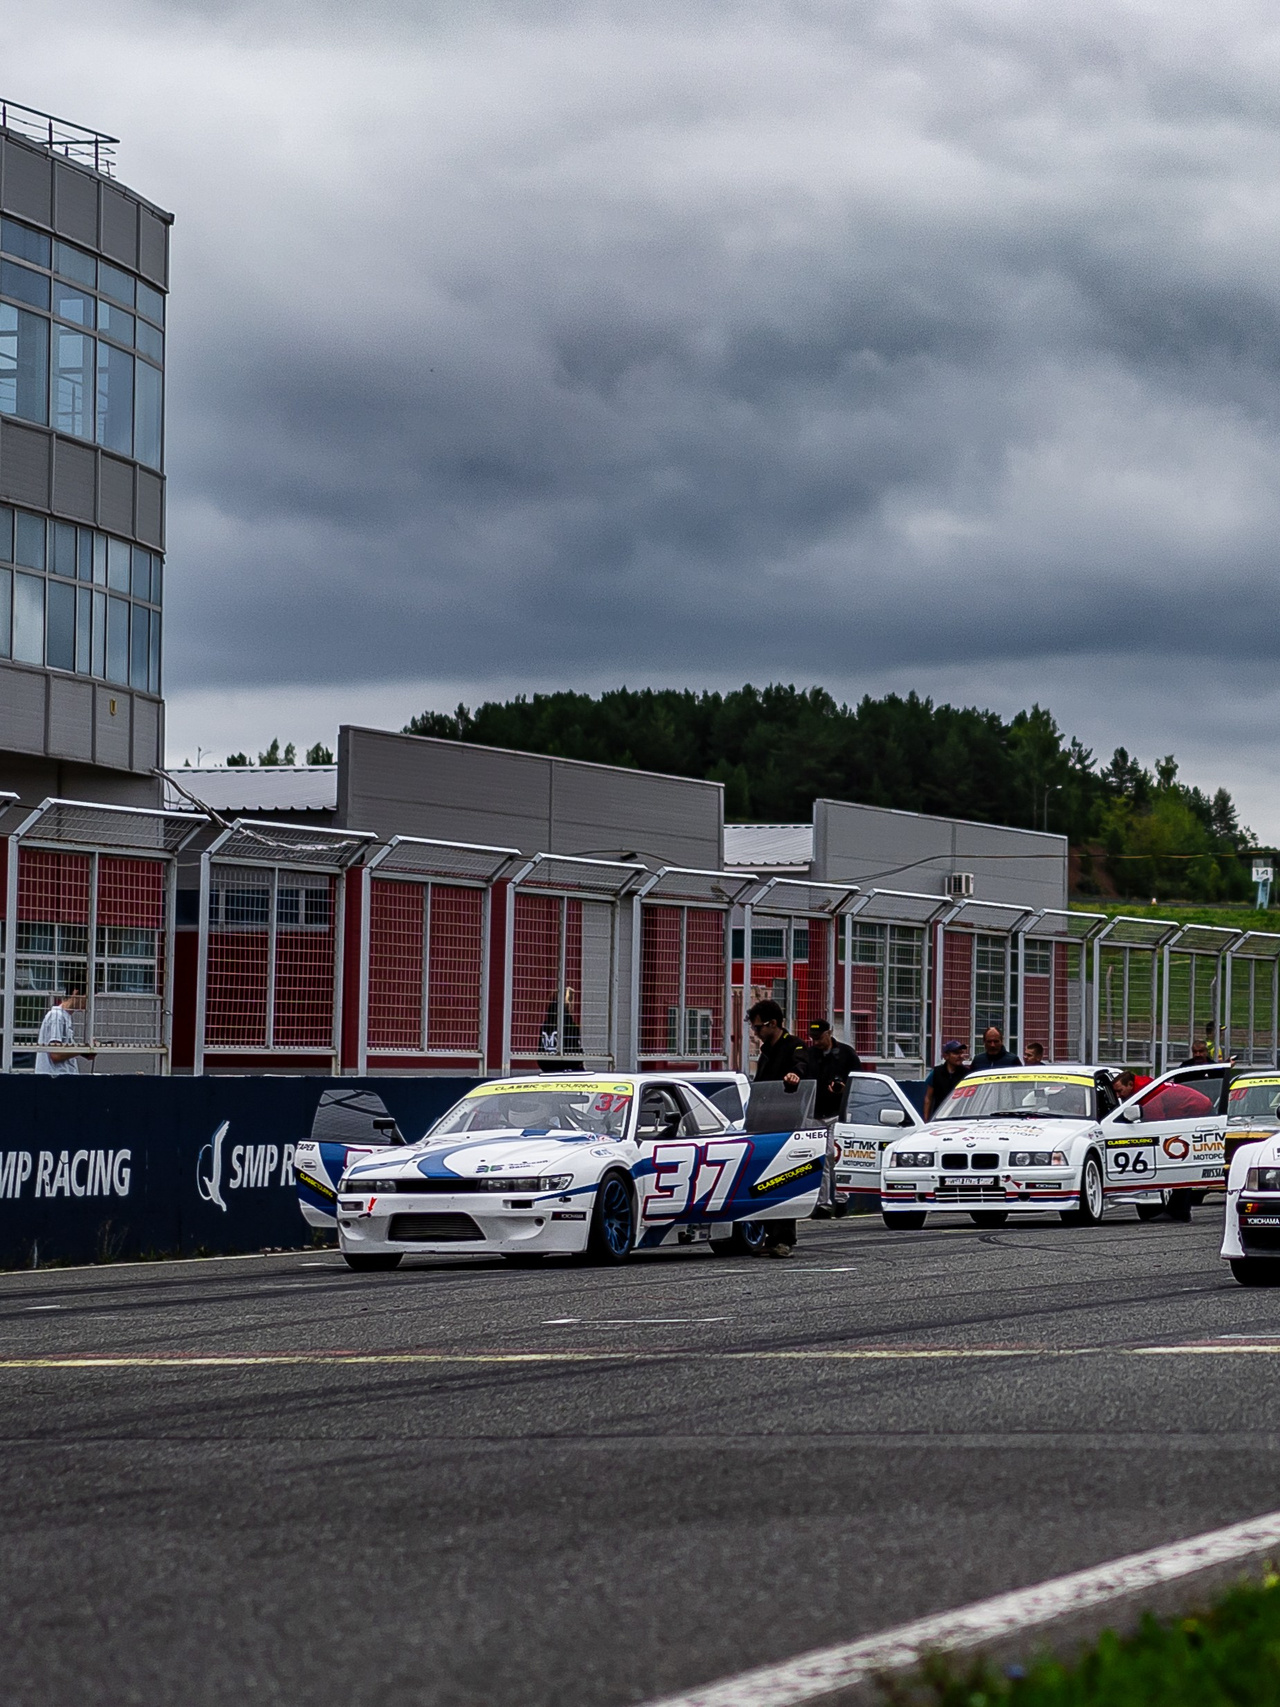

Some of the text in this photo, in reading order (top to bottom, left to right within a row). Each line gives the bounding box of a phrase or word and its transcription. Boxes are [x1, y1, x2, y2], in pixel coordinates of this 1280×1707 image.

[952, 1085, 978, 1099] 96
[595, 1094, 631, 1113] 37
[843, 1150, 876, 1159] UMMC
[844, 1140, 876, 1151] УГМК
[35, 1149, 131, 1197] RACING
[229, 1144, 277, 1188] SMP
[1113, 1151, 1148, 1174] 96
[644, 1142, 751, 1217] 37
